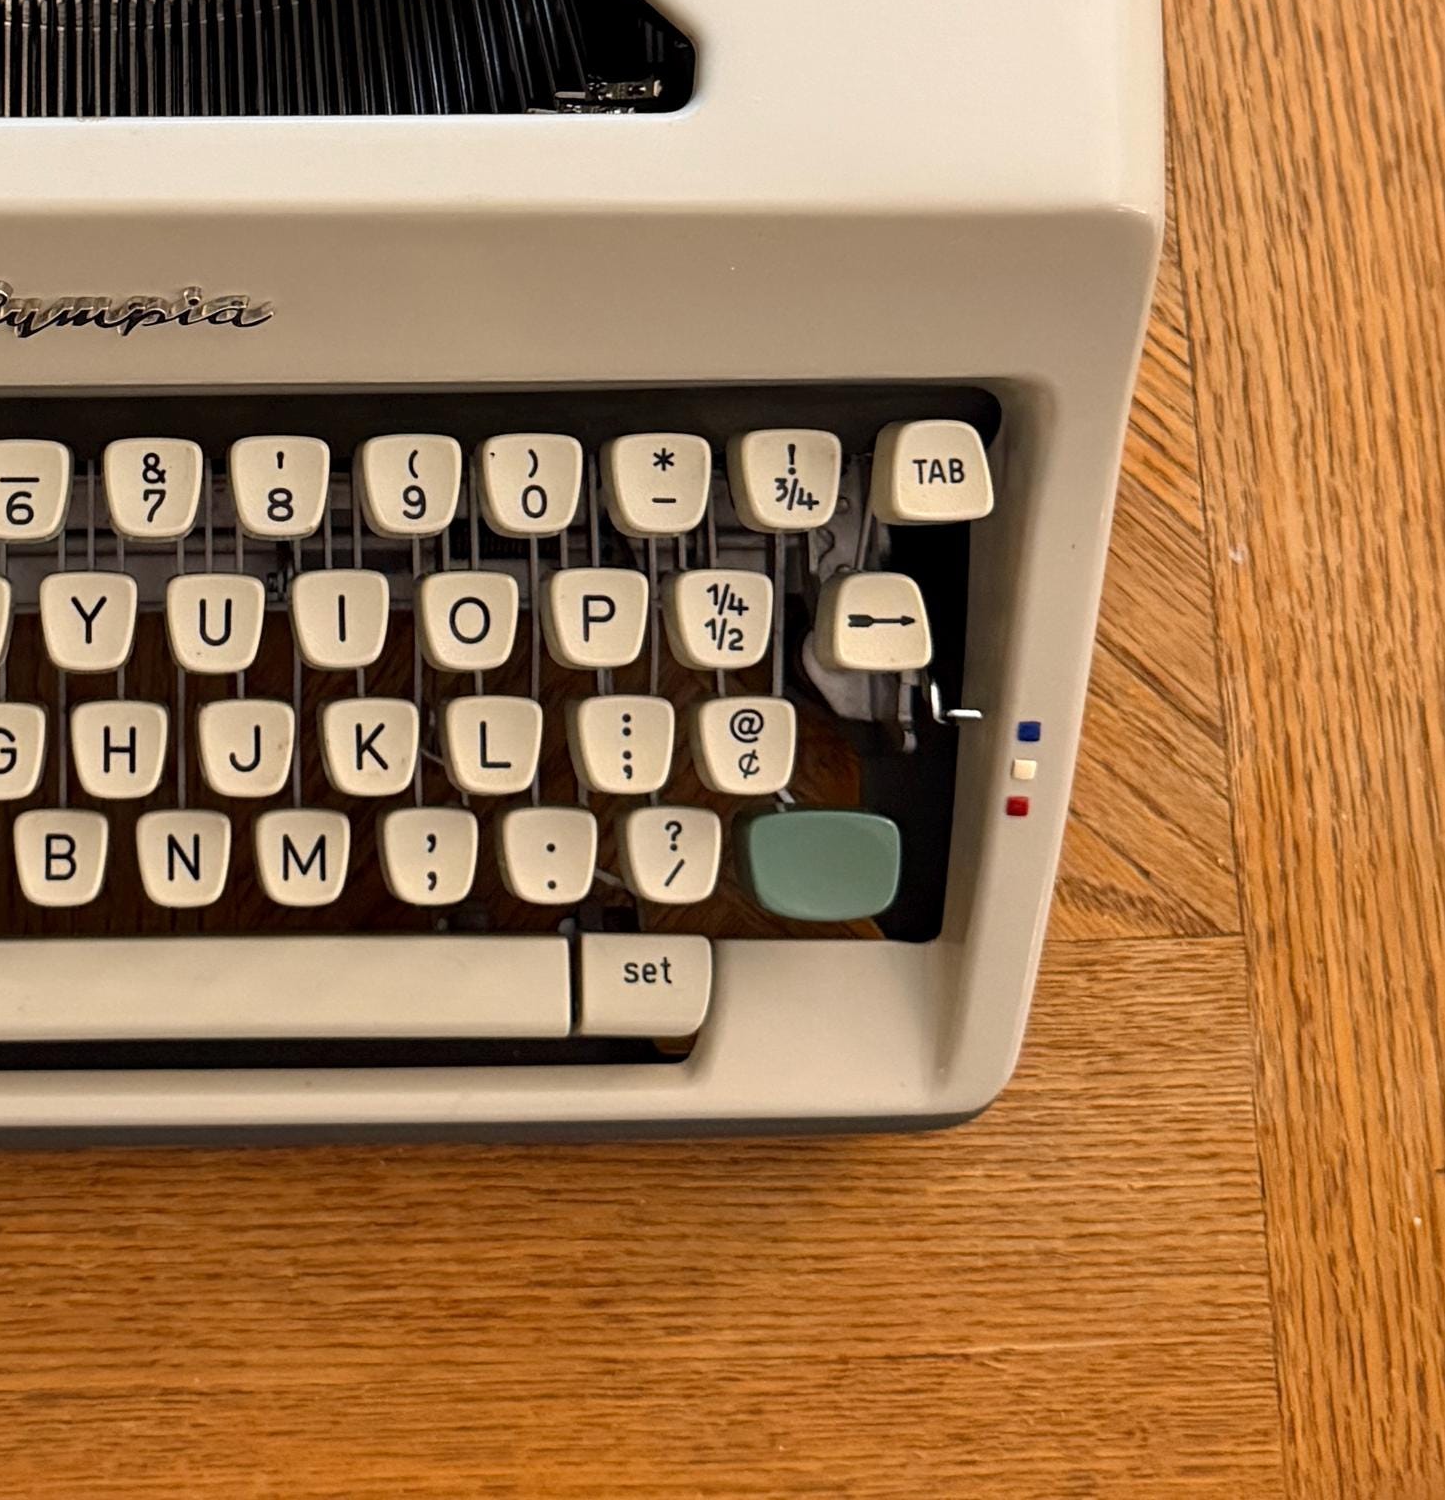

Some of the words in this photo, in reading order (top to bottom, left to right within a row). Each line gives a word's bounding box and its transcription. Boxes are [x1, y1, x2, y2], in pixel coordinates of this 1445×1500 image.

[141, 451, 168, 486] &
[786, 442, 798, 477] !
[911, 456, 966, 486] TAB
[4, 489, 36, 527] 6
[141, 487, 168, 524] 7
[266, 486, 295, 524] 8
[401, 483, 428, 521] 9
[69, 594, 108, 646] Y
[198, 597, 234, 648] U
[337, 593, 347, 644] I
[448, 595, 492, 646] O
[581, 593, 617, 643] P
[102, 724, 138, 775] H
[228, 723, 262, 774] J
[354, 721, 390, 772] K
[478, 719, 513, 770] L
[728, 707, 766, 745] @
[44, 832, 78, 882] B
[166, 832, 202, 883] N
[281, 833, 328, 883] M
[663, 819, 684, 853] ?
[623, 955, 674, 986] set
